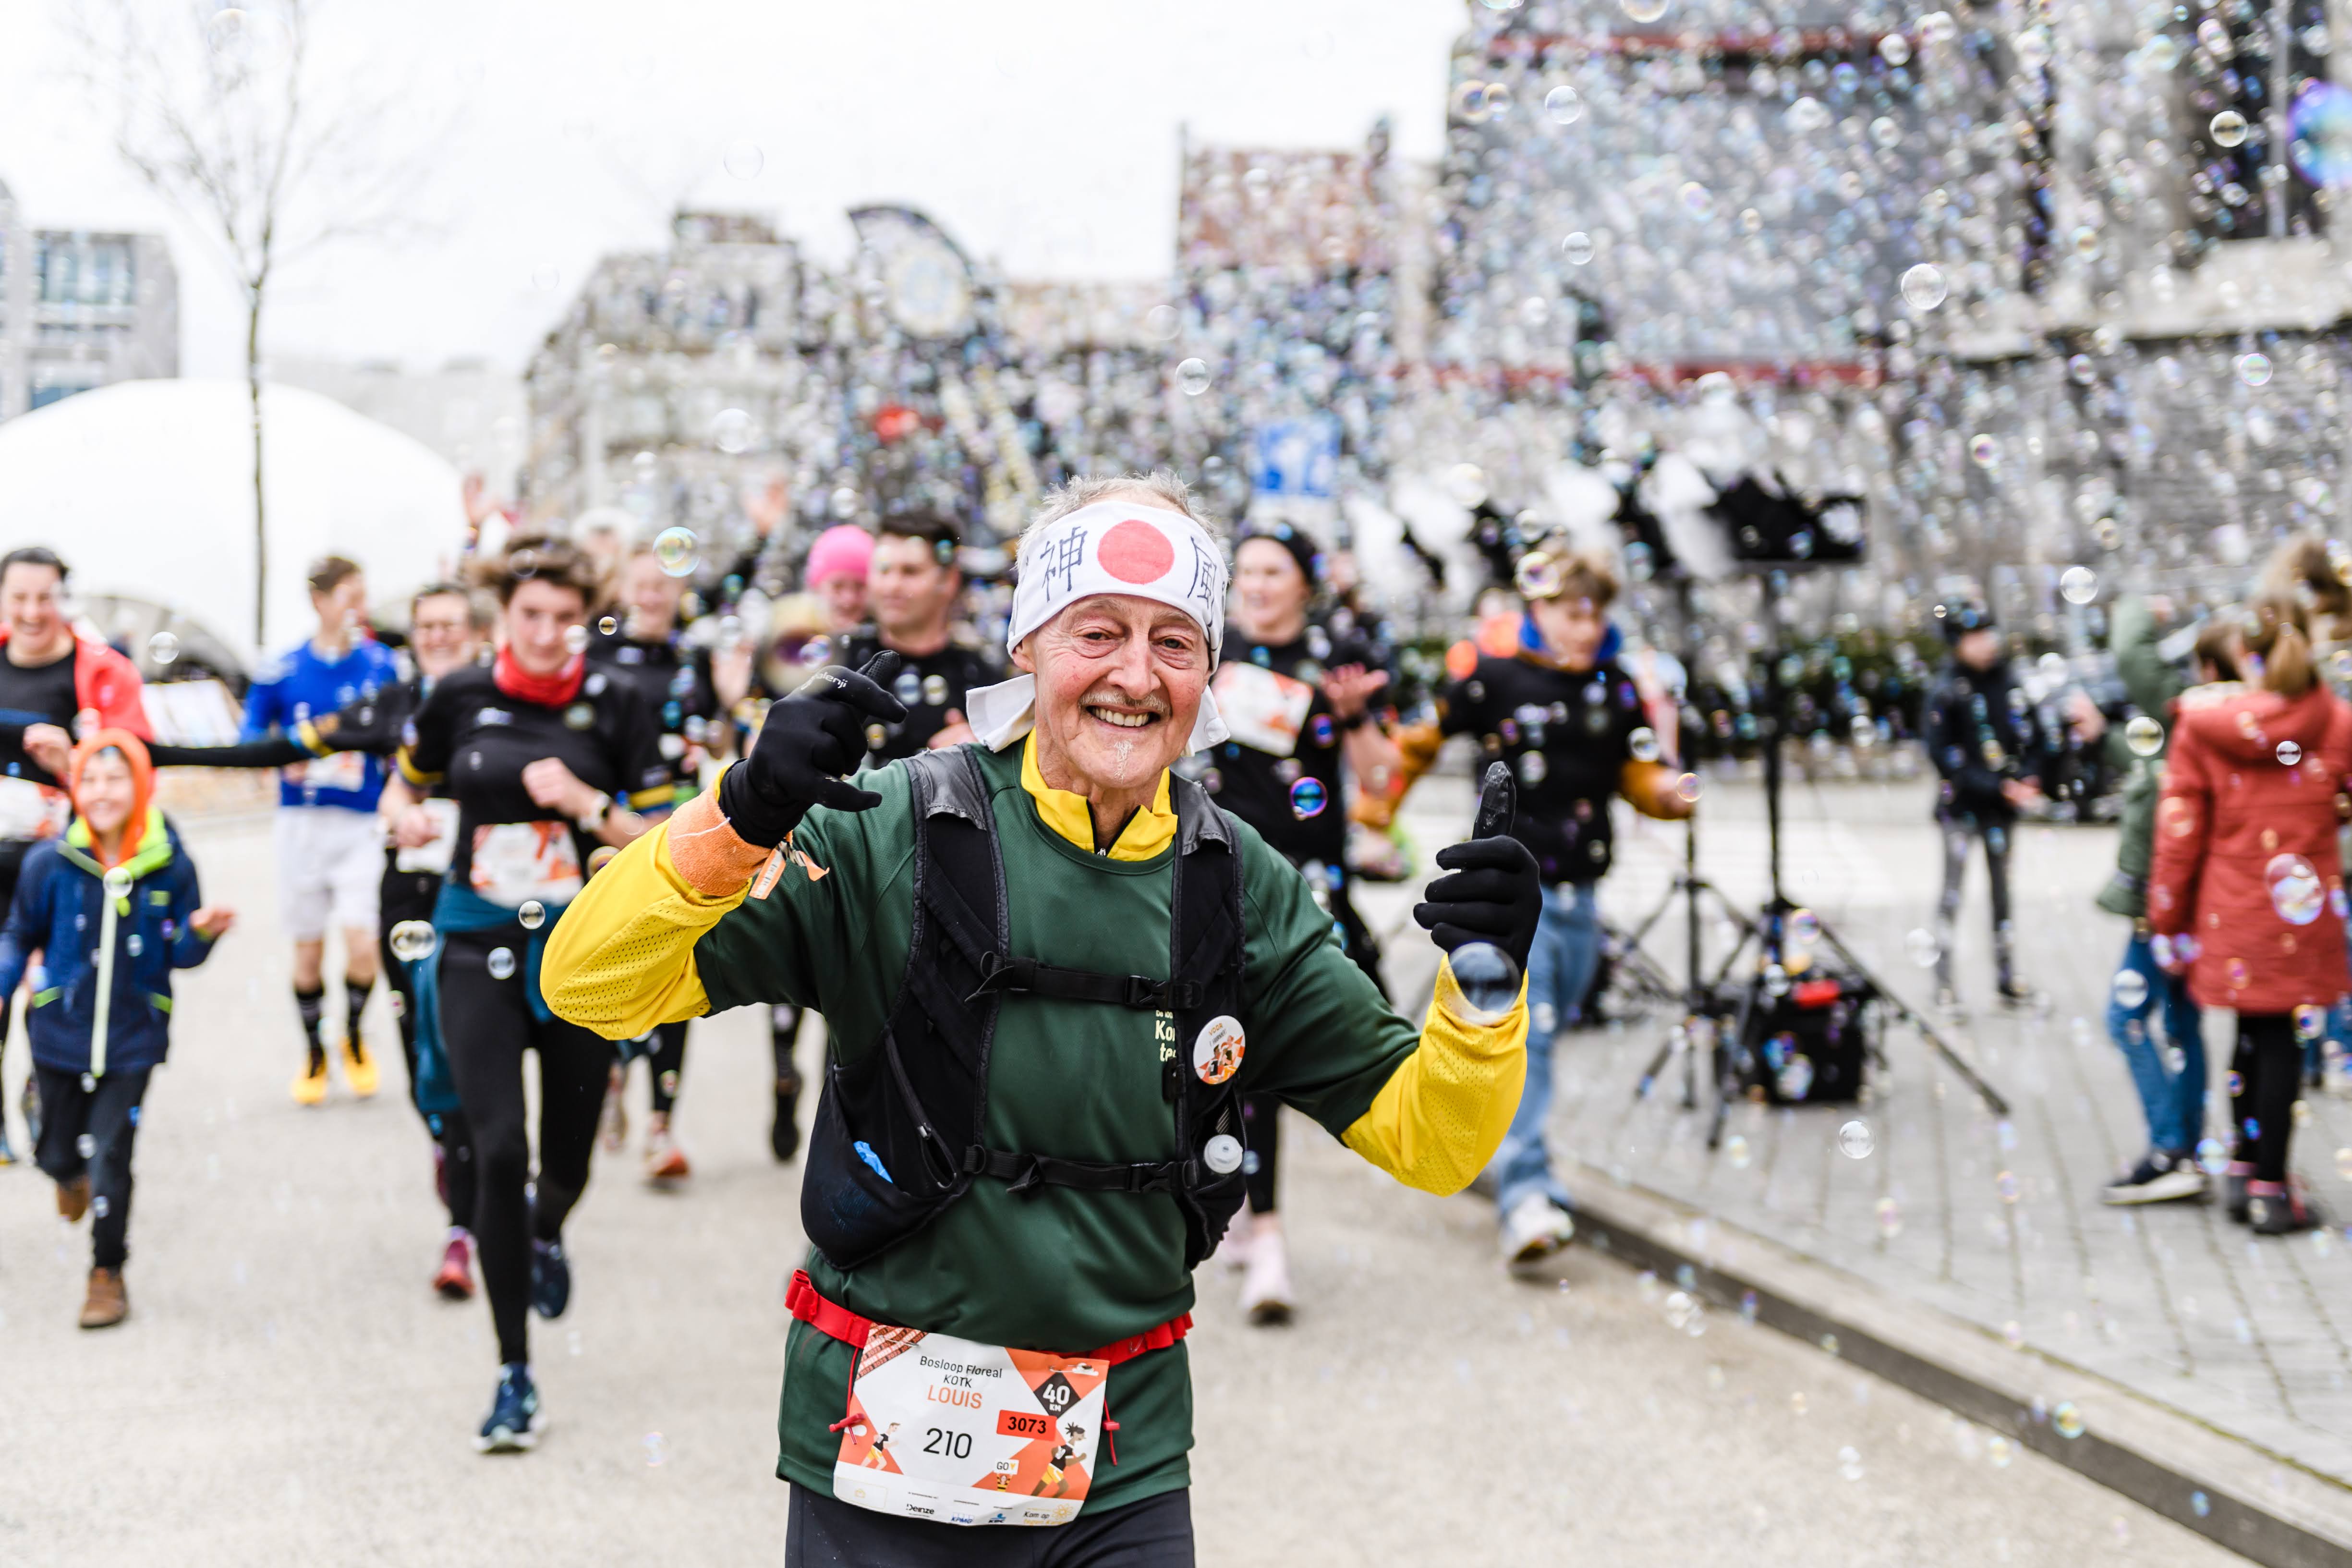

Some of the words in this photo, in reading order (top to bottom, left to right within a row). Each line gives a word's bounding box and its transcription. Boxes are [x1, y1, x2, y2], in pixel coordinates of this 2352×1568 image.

[920, 1356, 963, 1374] Bosloop
[966, 1365, 1003, 1378] Floreal
[943, 1374, 972, 1388] KOTK
[927, 1384, 982, 1409] LOUIS
[1043, 1384, 1070, 1405] 40
[1049, 1403, 1062, 1412] KM
[1007, 1416, 1046, 1434] 3073
[923, 1428, 973, 1459] 210
[996, 1461, 1009, 1471] GO
